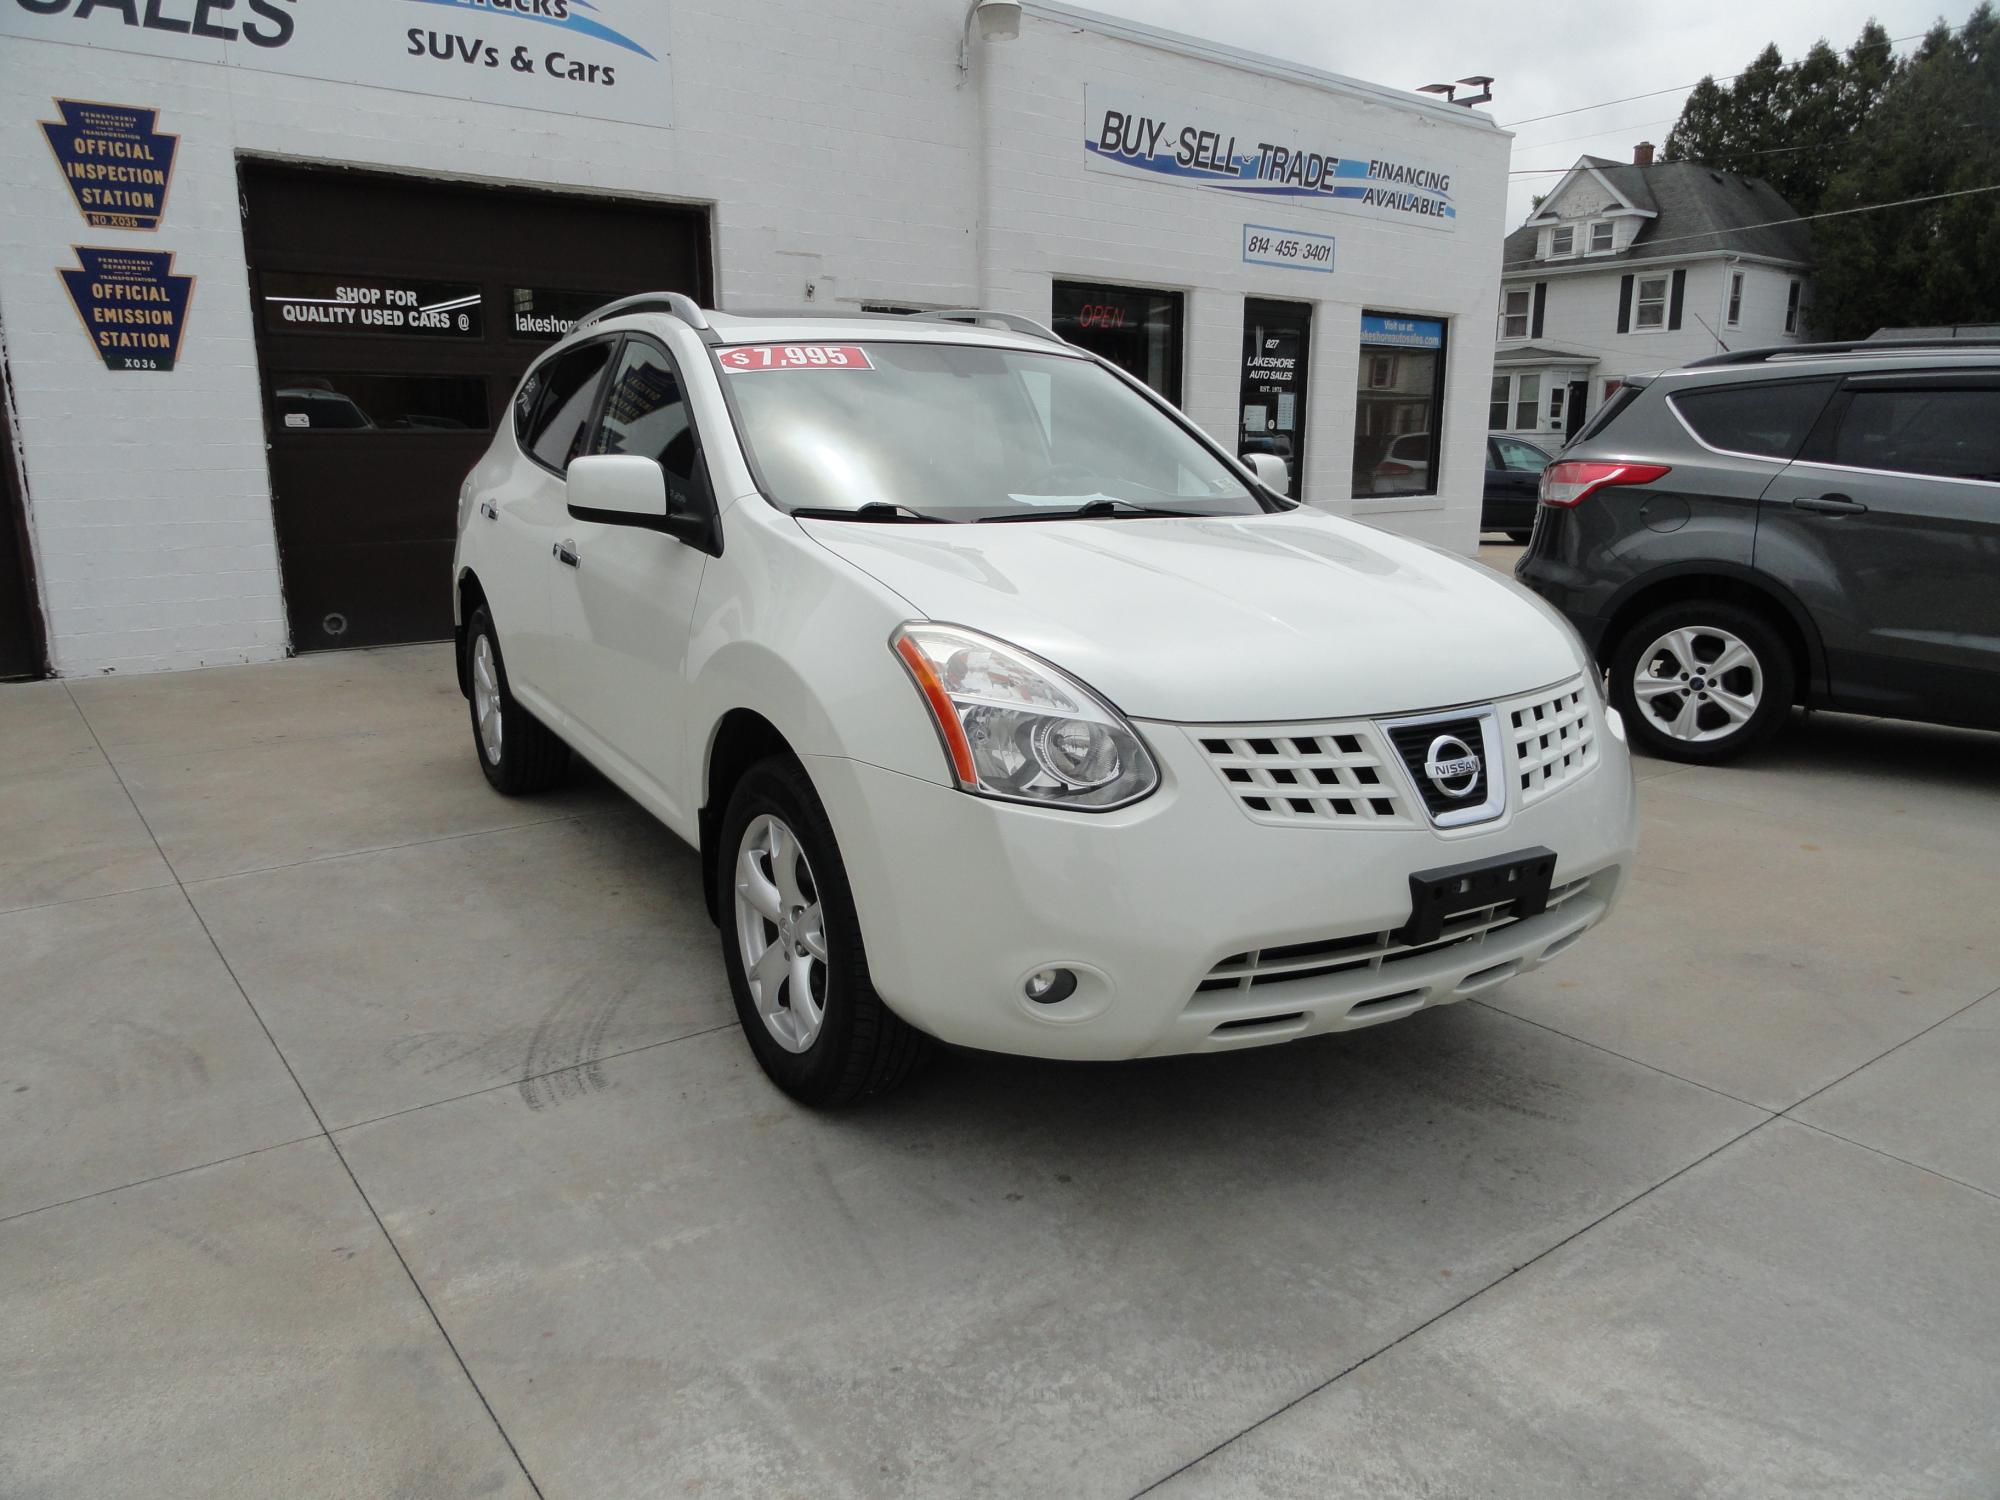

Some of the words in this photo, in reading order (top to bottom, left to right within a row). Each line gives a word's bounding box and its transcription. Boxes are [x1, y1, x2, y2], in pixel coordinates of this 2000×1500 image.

[15, 0, 294, 48] LES
[407, 28, 499, 67] SUVs
[510, 46, 535, 73] &
[545, 52, 615, 86] Cars
[74, 138, 154, 160] OFFICIAL
[1100, 110, 1166, 159] BUY
[1176, 126, 1240, 175] SELL
[1257, 143, 1338, 191] TRADE
[67, 162, 164, 185] INSPECTION
[1368, 160, 1450, 191] FINANCING
[82, 188, 154, 208] STATION
[1363, 188, 1446, 217] AVAILABLE
[92, 283, 170, 301] OFFICIAL
[336, 287, 380, 304] SHOP
[386, 290, 418, 306] FOR
[93, 308, 173, 325] EMISSION
[283, 305, 355, 324] QUALITY
[361, 309, 403, 326] USED
[408, 311, 450, 328] CARS
[458, 314, 470, 331] @
[515, 313, 579, 333] lakeshor
[1080, 304, 1125, 328] OPEN
[100, 331, 170, 348] STATION
[1265, 339, 1279, 349] 827
[125, 358, 156, 369] X036
[1247, 356, 1295, 368] LAKESHORE
[1249, 370, 1270, 379] AUTO
[1270, 371, 1293, 380] SALES
[1435, 758, 1478, 776] NISSAN
